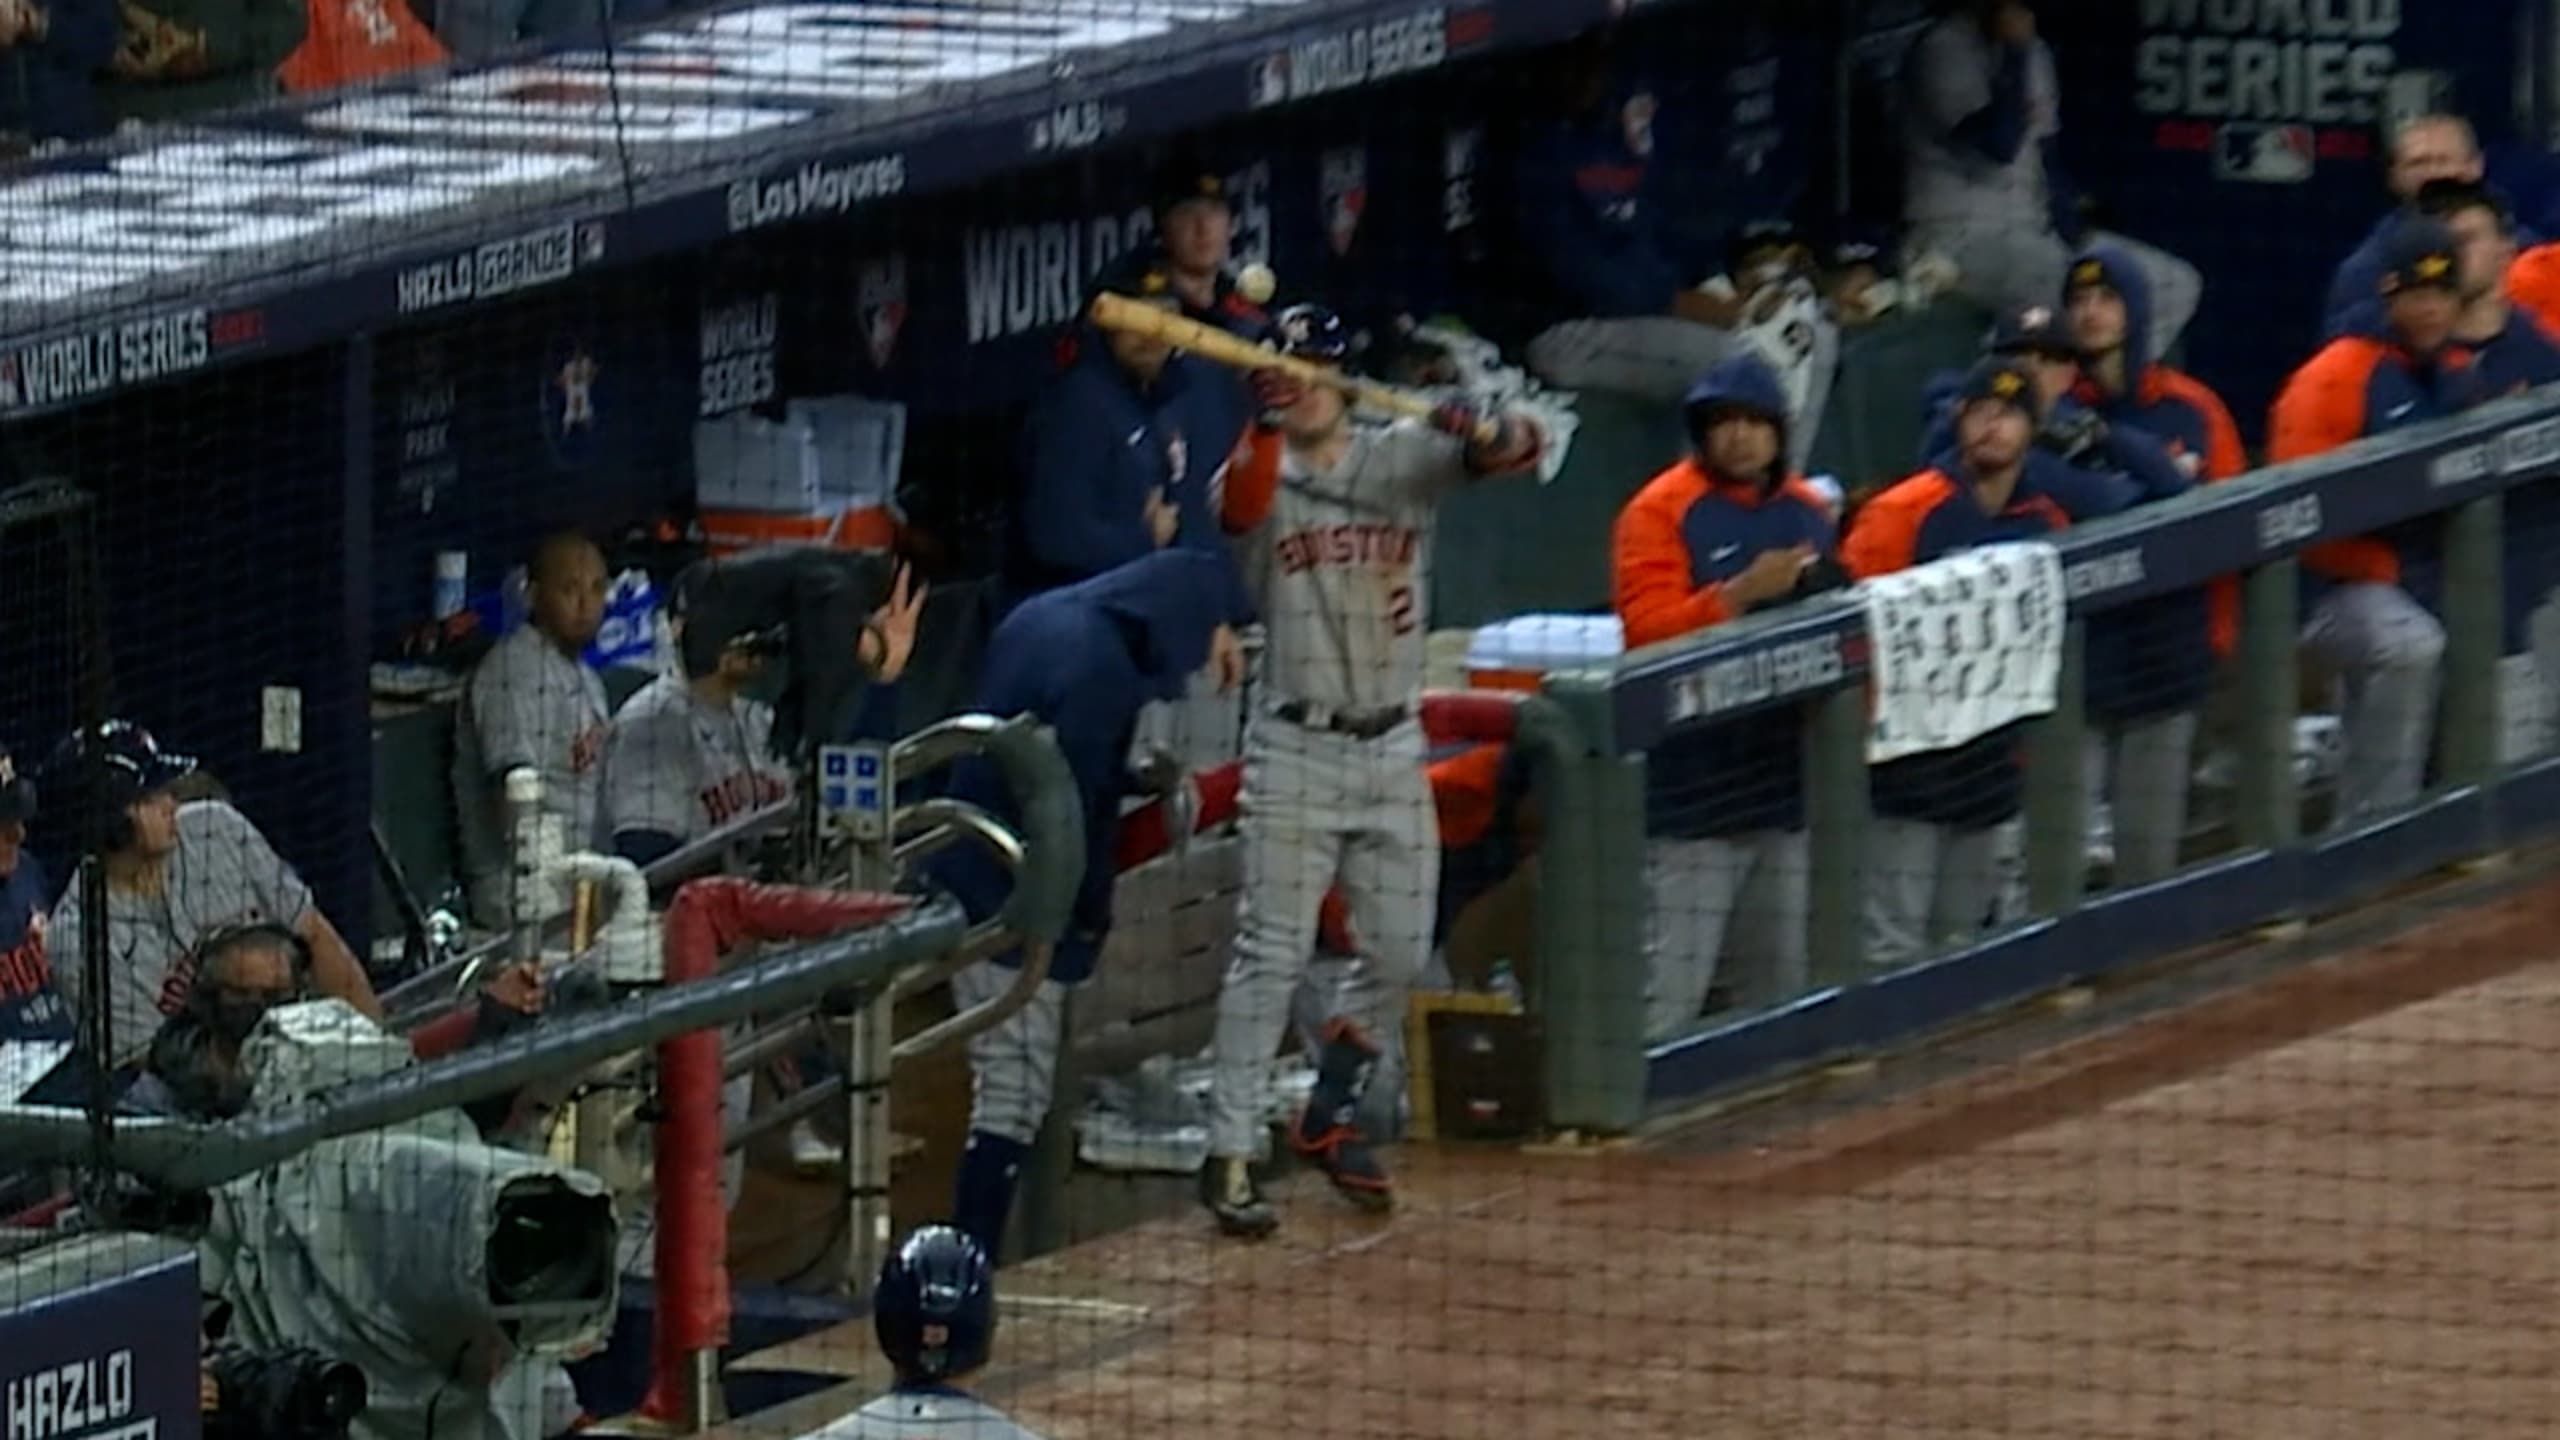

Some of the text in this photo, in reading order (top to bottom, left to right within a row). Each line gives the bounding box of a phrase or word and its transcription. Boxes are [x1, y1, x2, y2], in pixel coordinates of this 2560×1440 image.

[2137, 35, 2396, 122] SERIES
[22, 325, 114, 406] WORLD
[119, 307, 209, 383] SERIES
[8, 1349, 132, 1440] HAZLO
